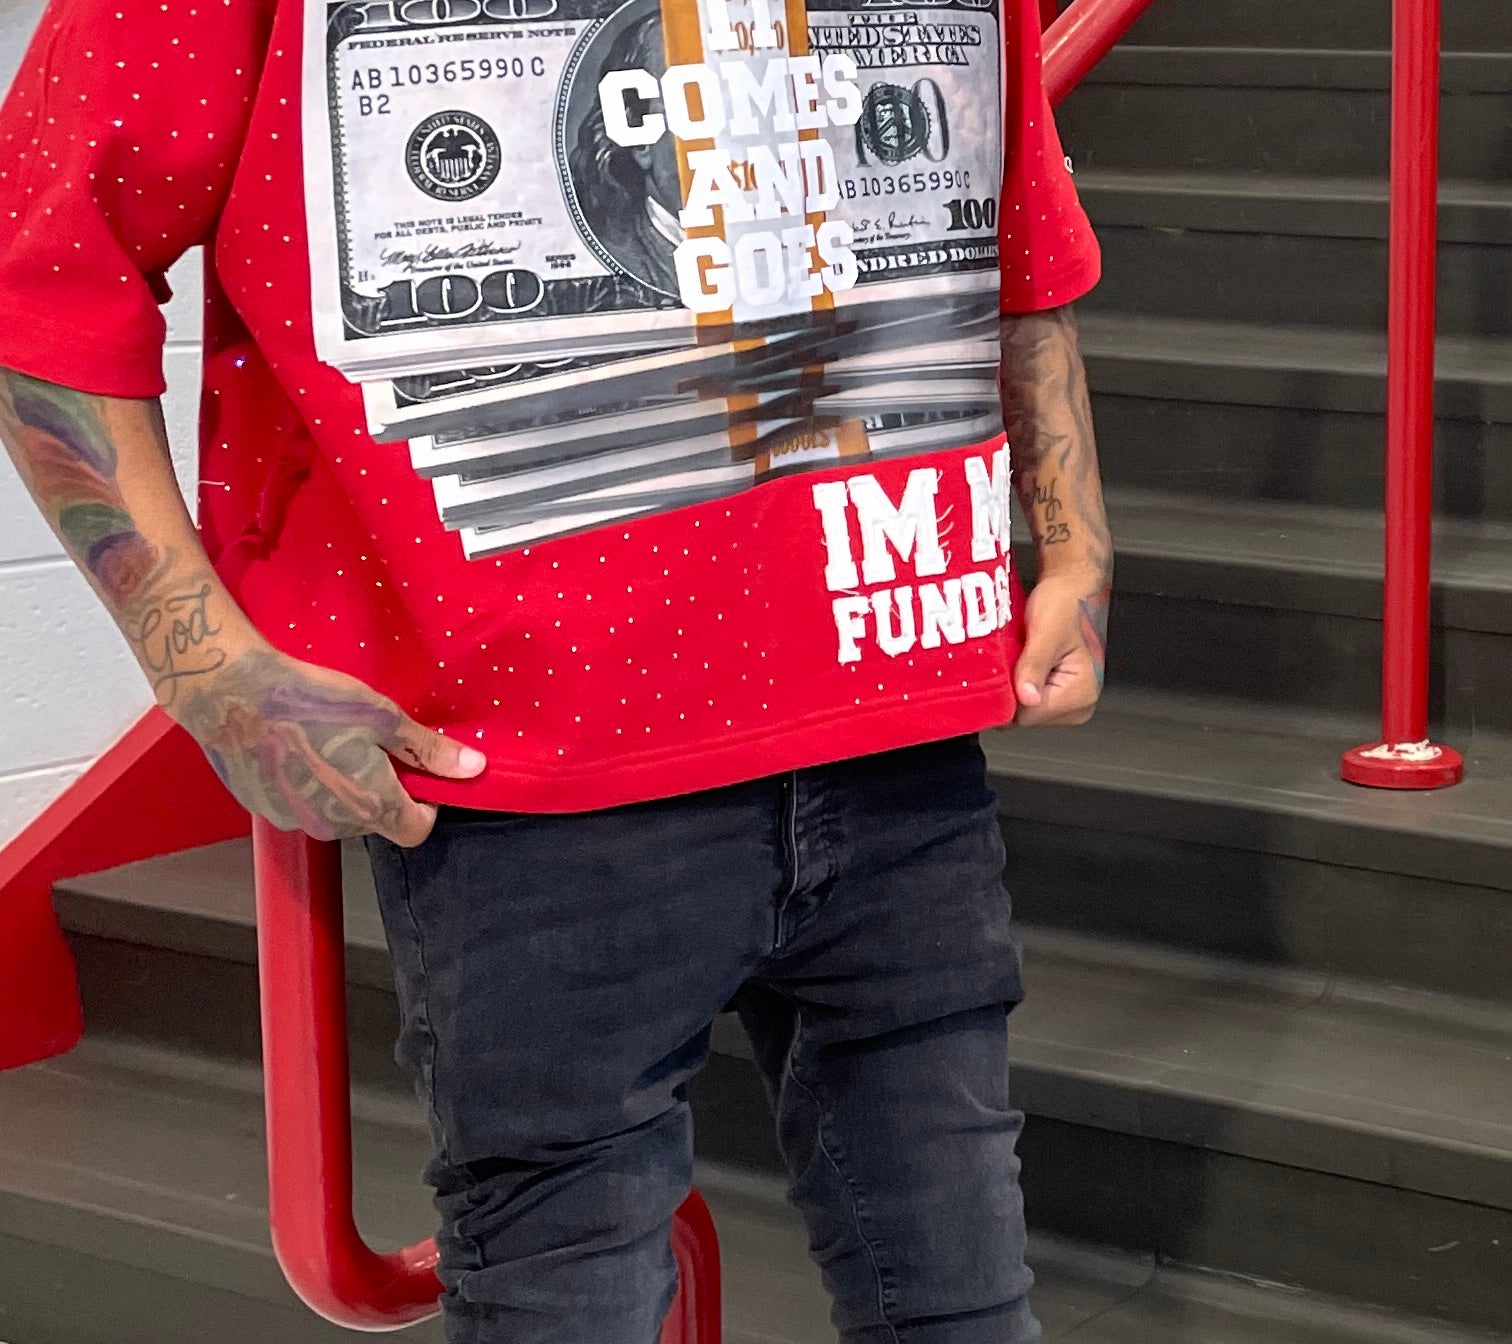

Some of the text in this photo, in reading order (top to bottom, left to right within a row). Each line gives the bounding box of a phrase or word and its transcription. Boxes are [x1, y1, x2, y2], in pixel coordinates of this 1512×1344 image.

[346, 26, 577, 51] FEDERAL RESERVE NOTE
[883, 23, 982, 47] STATES
[359, 93, 392, 117] B2
[597, 53, 864, 147] COMES
[679, 138, 841, 228] AND
[942, 197, 997, 232] 100
[672, 220, 861, 313] GOES
[857, 249, 948, 273] NDRED
[377, 268, 545, 327] 100
[811, 467, 948, 592] IM
